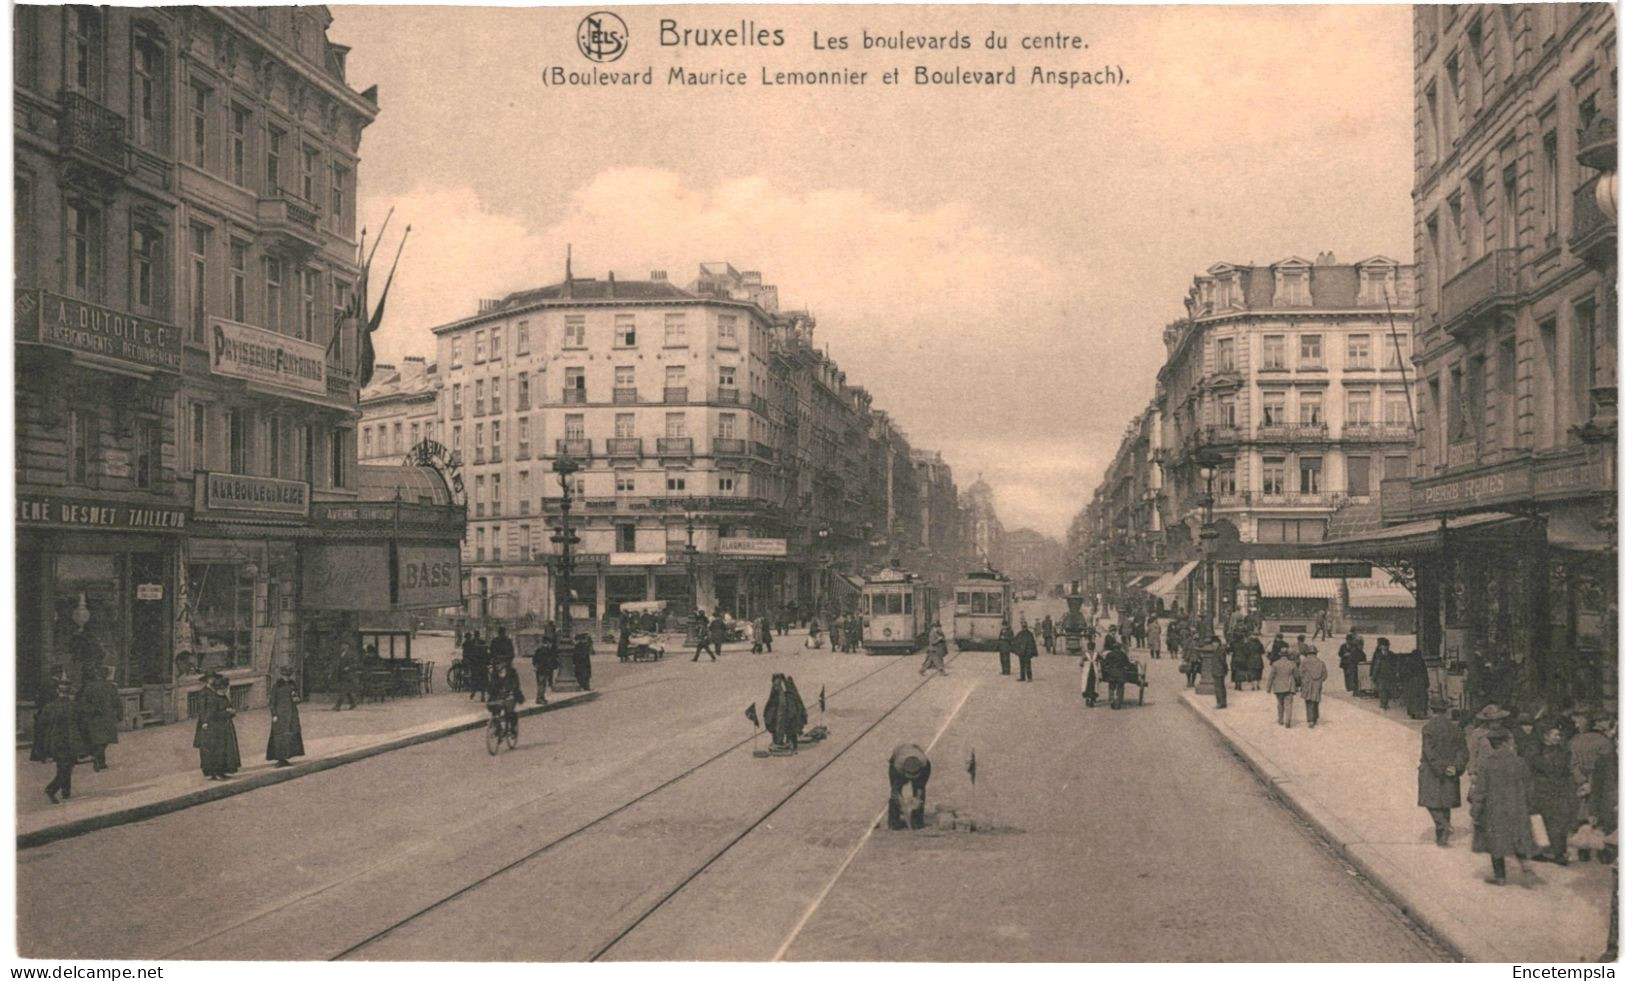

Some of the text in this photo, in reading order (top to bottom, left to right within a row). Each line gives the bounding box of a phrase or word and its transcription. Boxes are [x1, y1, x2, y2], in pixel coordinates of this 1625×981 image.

[80, 306, 138, 341] DUTOIT
[143, 327, 151, 345] &
[15, 498, 185, 528] ENÉ DESMET TAILLEUR
[406, 562, 452, 589] BASS
